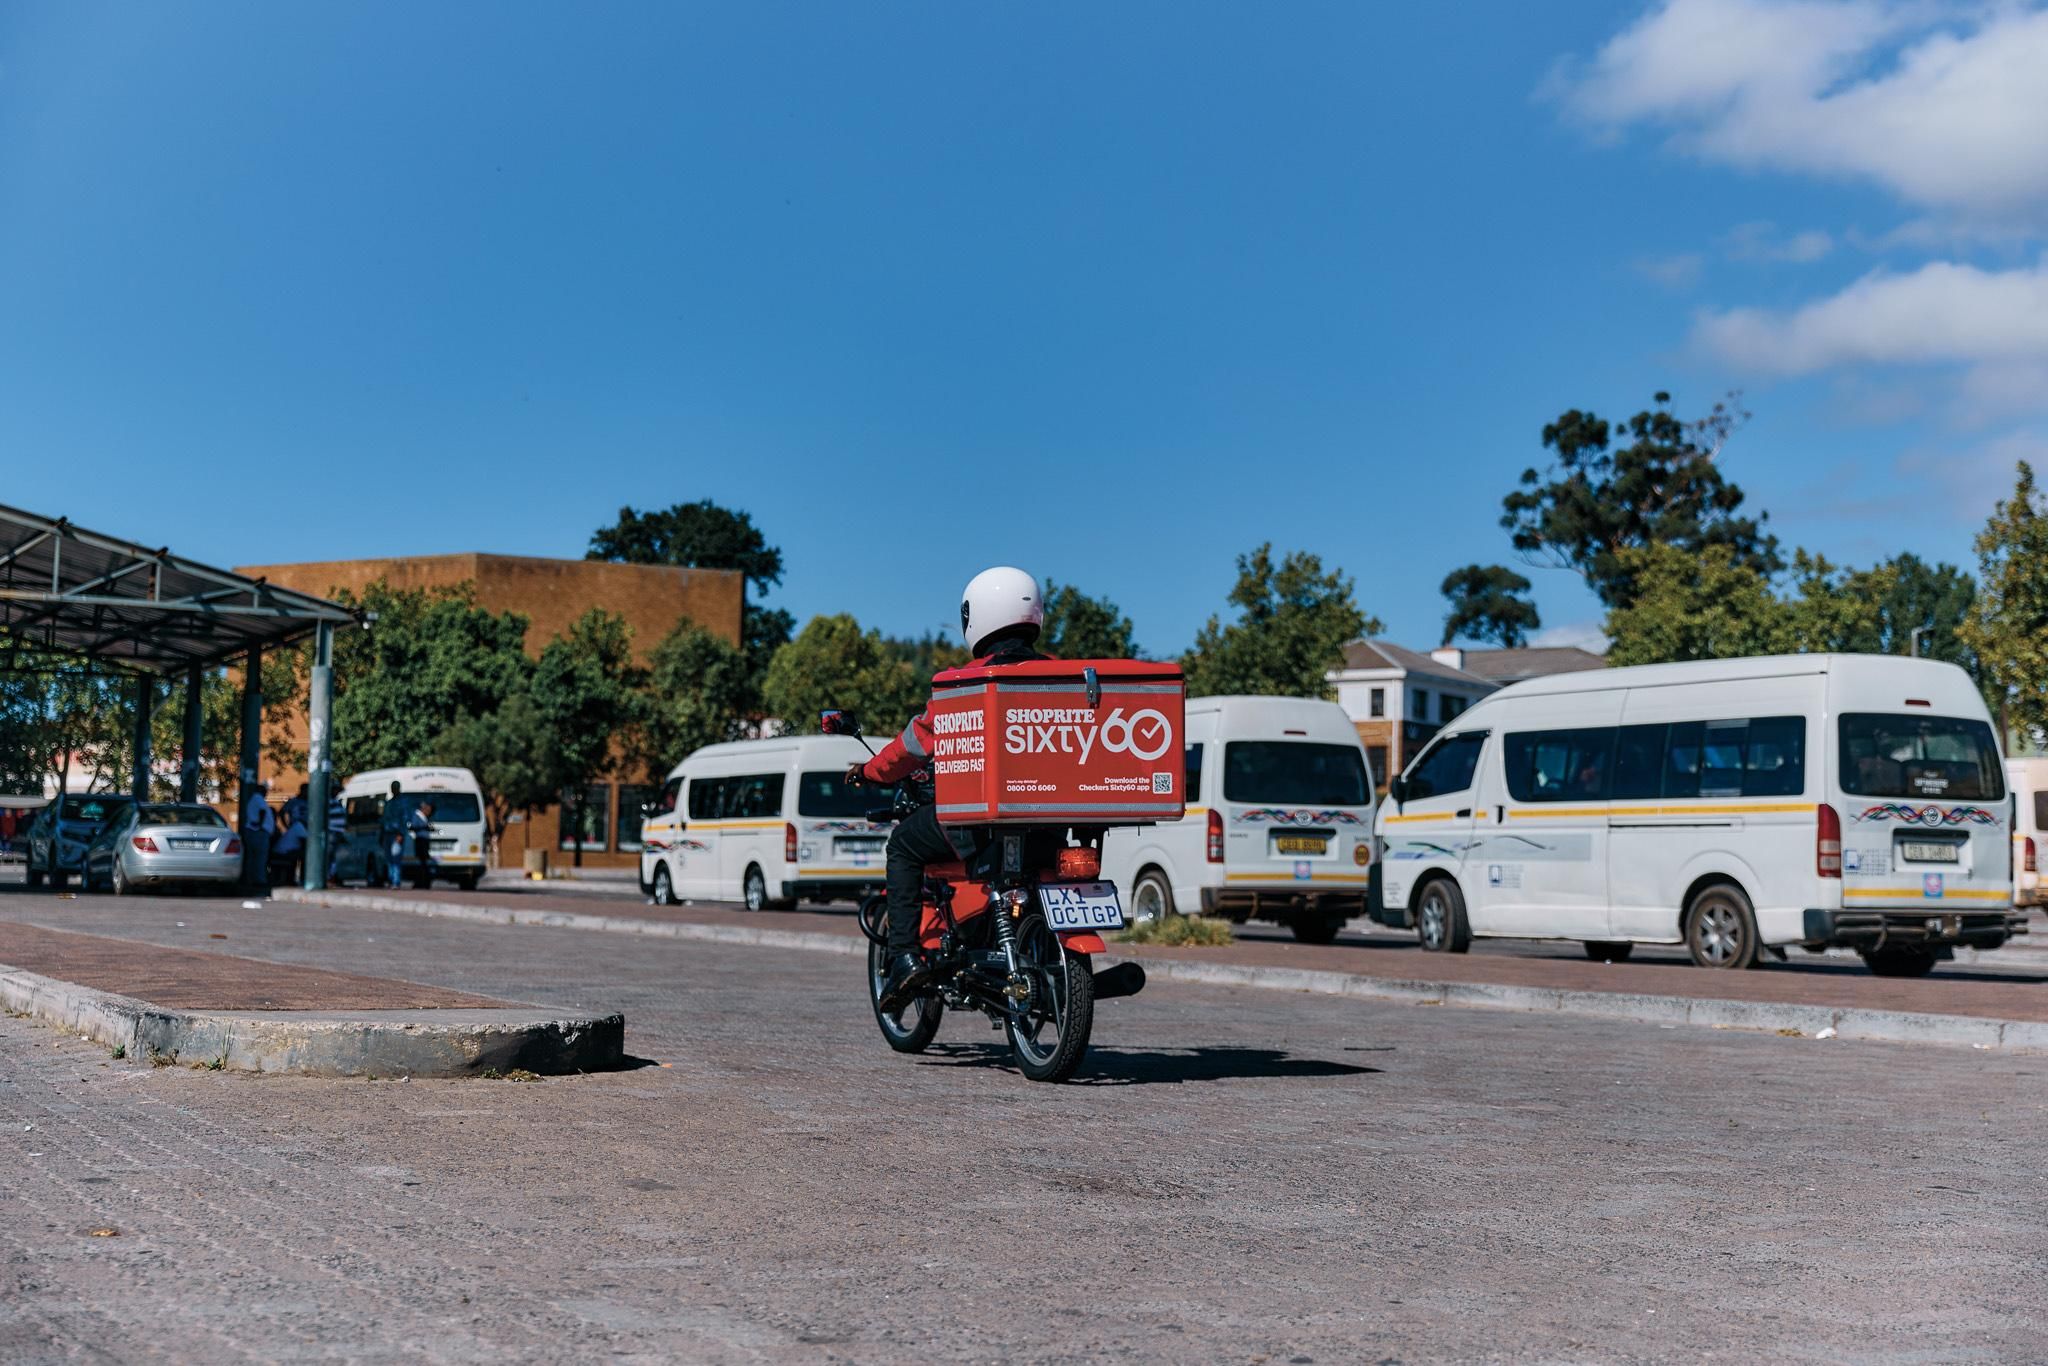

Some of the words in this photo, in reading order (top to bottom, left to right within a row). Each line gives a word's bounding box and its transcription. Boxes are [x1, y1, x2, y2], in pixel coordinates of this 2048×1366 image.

[934, 710, 984, 734] SHOPRITE
[1006, 708, 1096, 724] SHOPRITE
[934, 738, 955, 756] LOW
[956, 736, 985, 755] PRICES
[934, 759, 970, 775] DELIVERED
[970, 758, 985, 772] FAST
[1026, 784, 1037, 792] 00
[1045, 887, 1086, 905] LX1
